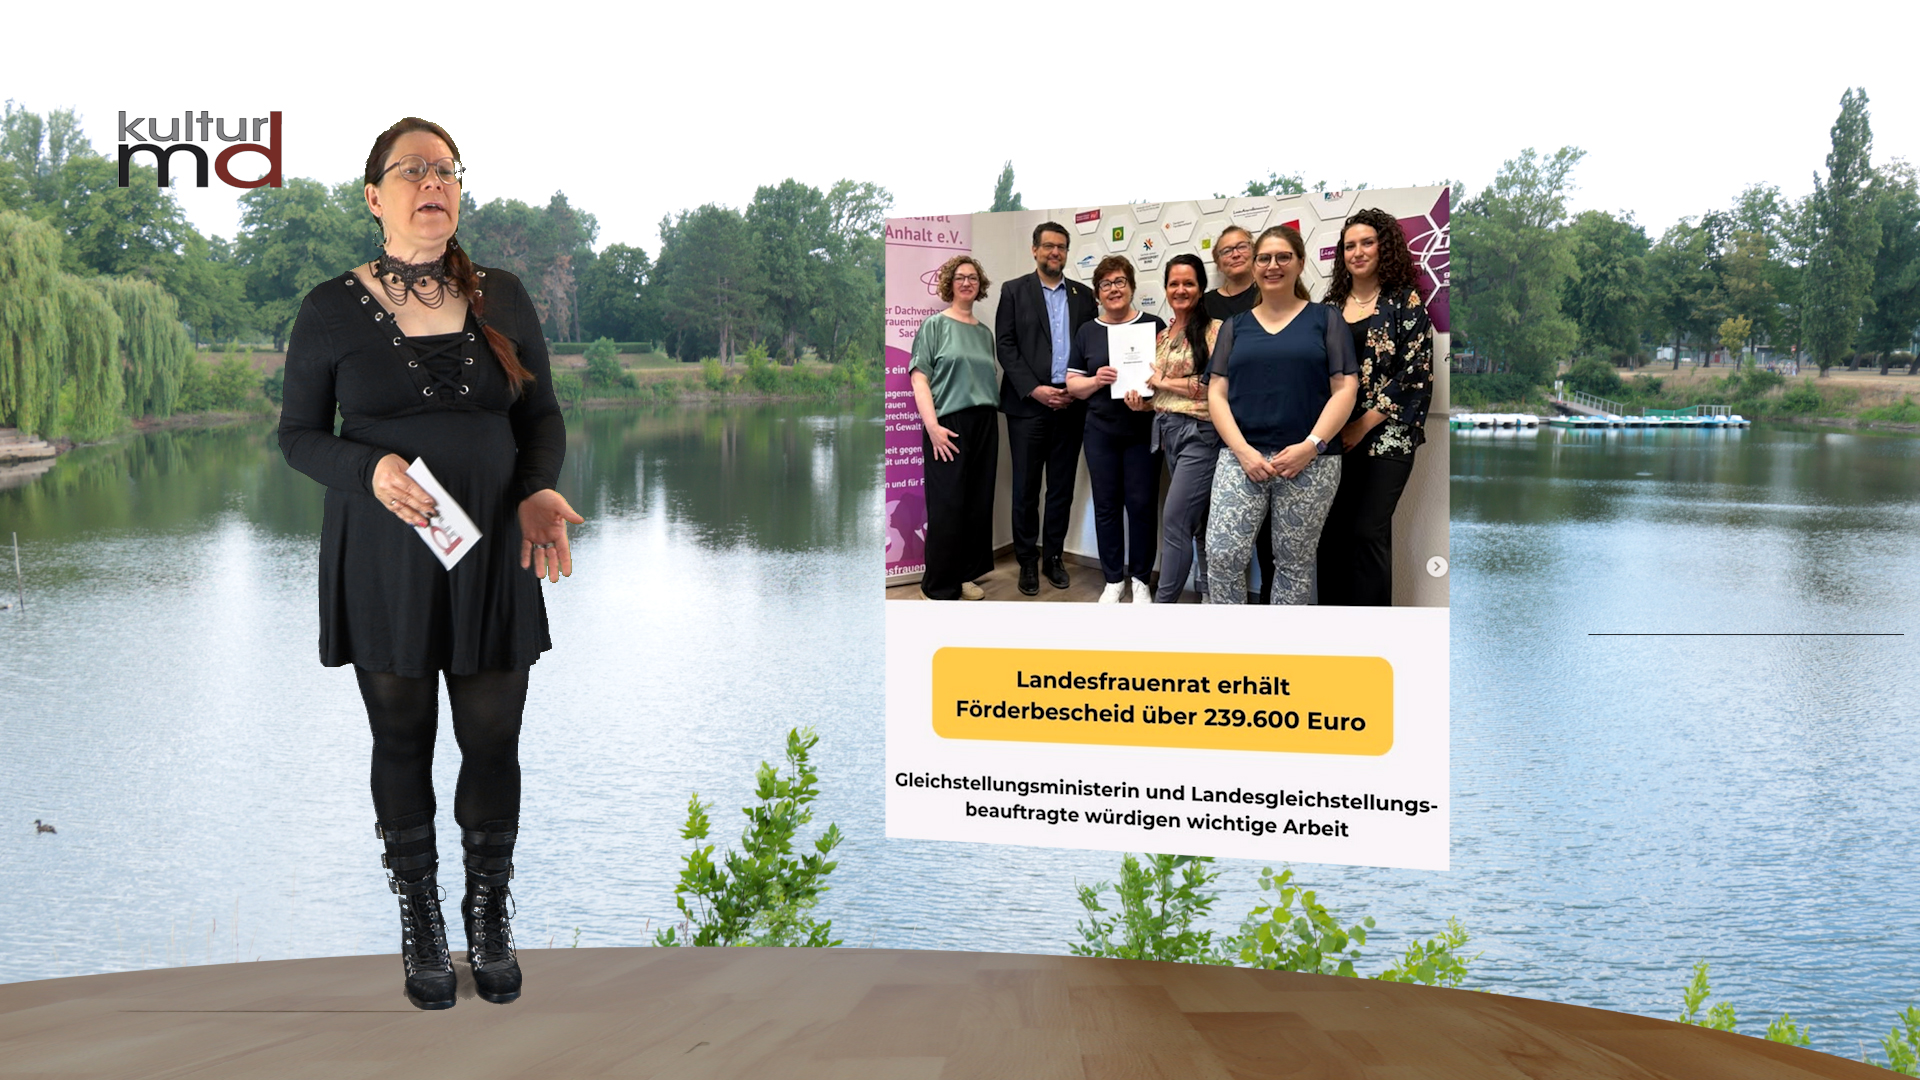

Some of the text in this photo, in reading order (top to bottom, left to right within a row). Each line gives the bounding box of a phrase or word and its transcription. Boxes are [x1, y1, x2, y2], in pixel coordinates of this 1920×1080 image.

[885, 224, 964, 244] Anhalt e.V.
[892, 365, 907, 374] ein
[895, 423, 922, 432] Gewalt
[899, 446, 922, 456] gegen
[894, 456, 910, 466] und
[891, 479, 907, 488] und
[907, 478, 919, 487] für
